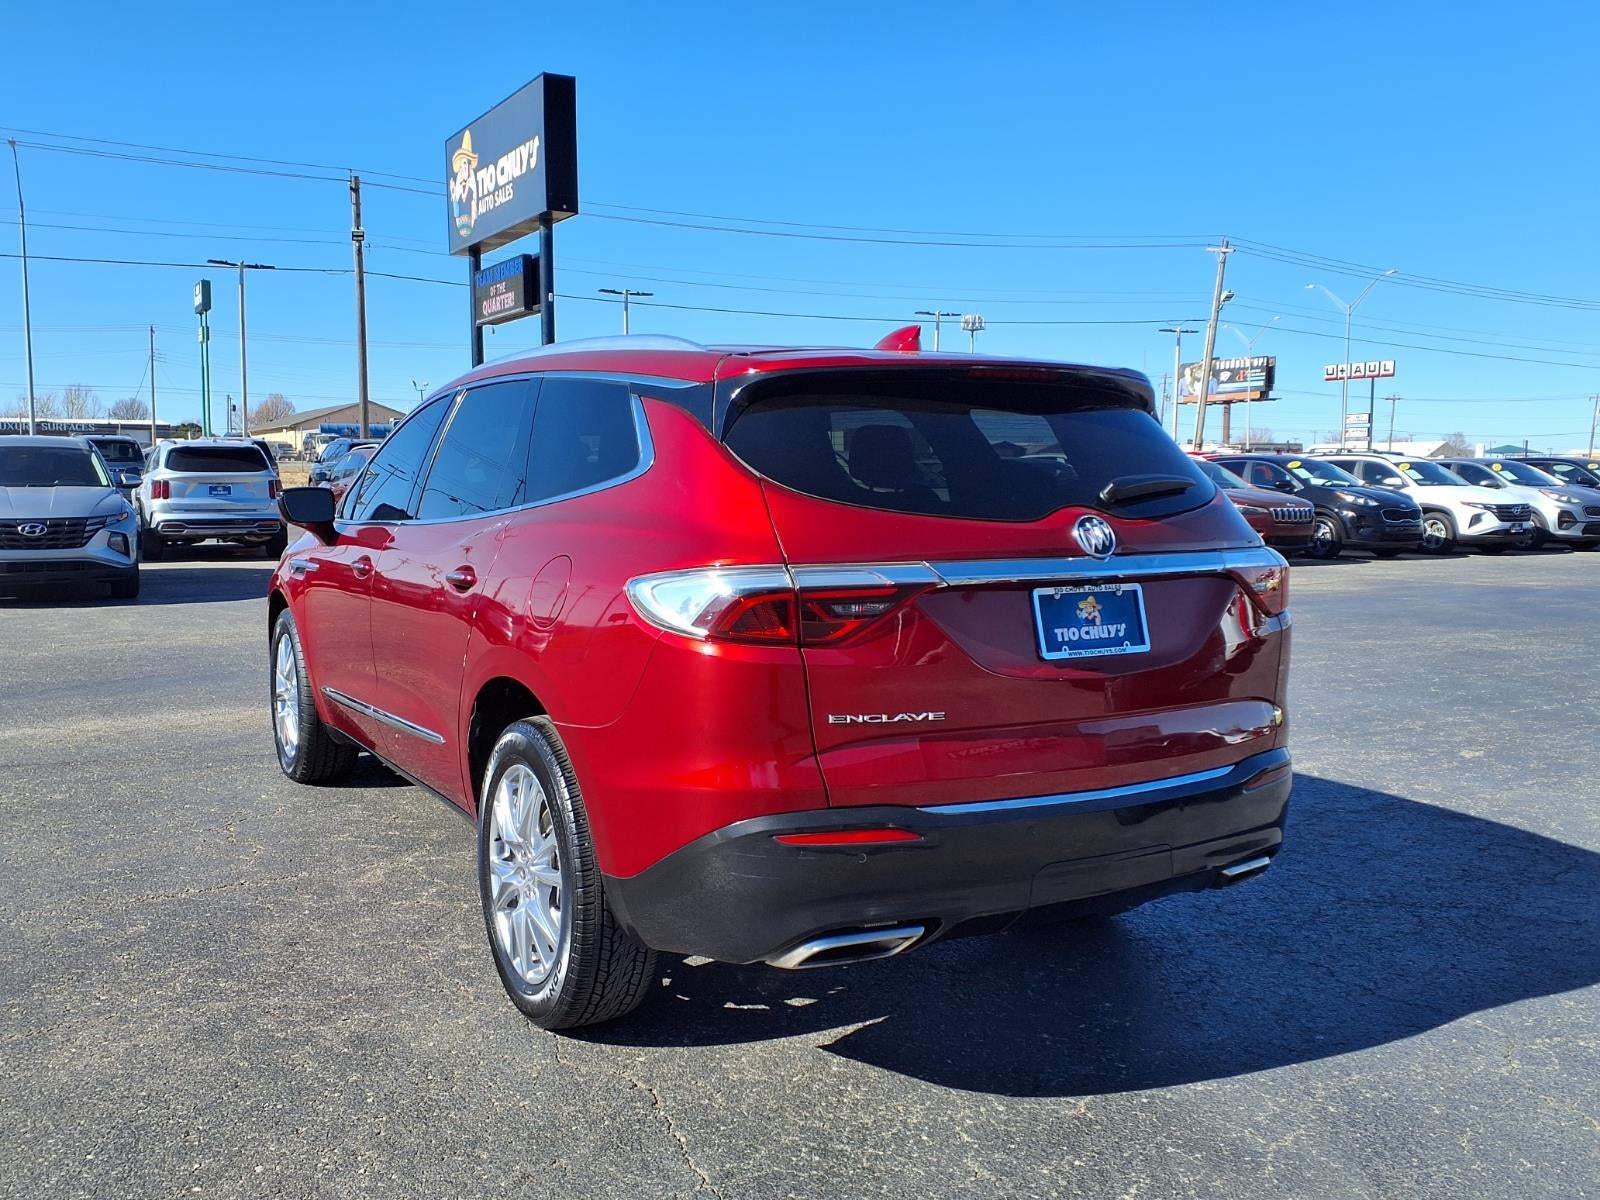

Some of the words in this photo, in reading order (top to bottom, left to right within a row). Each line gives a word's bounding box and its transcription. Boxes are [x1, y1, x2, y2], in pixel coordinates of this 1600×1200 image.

[476, 163, 496, 198] TIO
[496, 135, 540, 187] CHUY'S
[478, 195, 494, 216] AUTO
[495, 182, 514, 207] SALES
[490, 284, 497, 297] OF
[496, 281, 506, 295] THE
[482, 290, 515, 317] QUARTER!
[41, 422, 95, 432] SURFACES
[1054, 627, 1080, 642] TIO
[1080, 623, 1126, 640] CHUY'S
[828, 711, 945, 724] ENCLAVE
